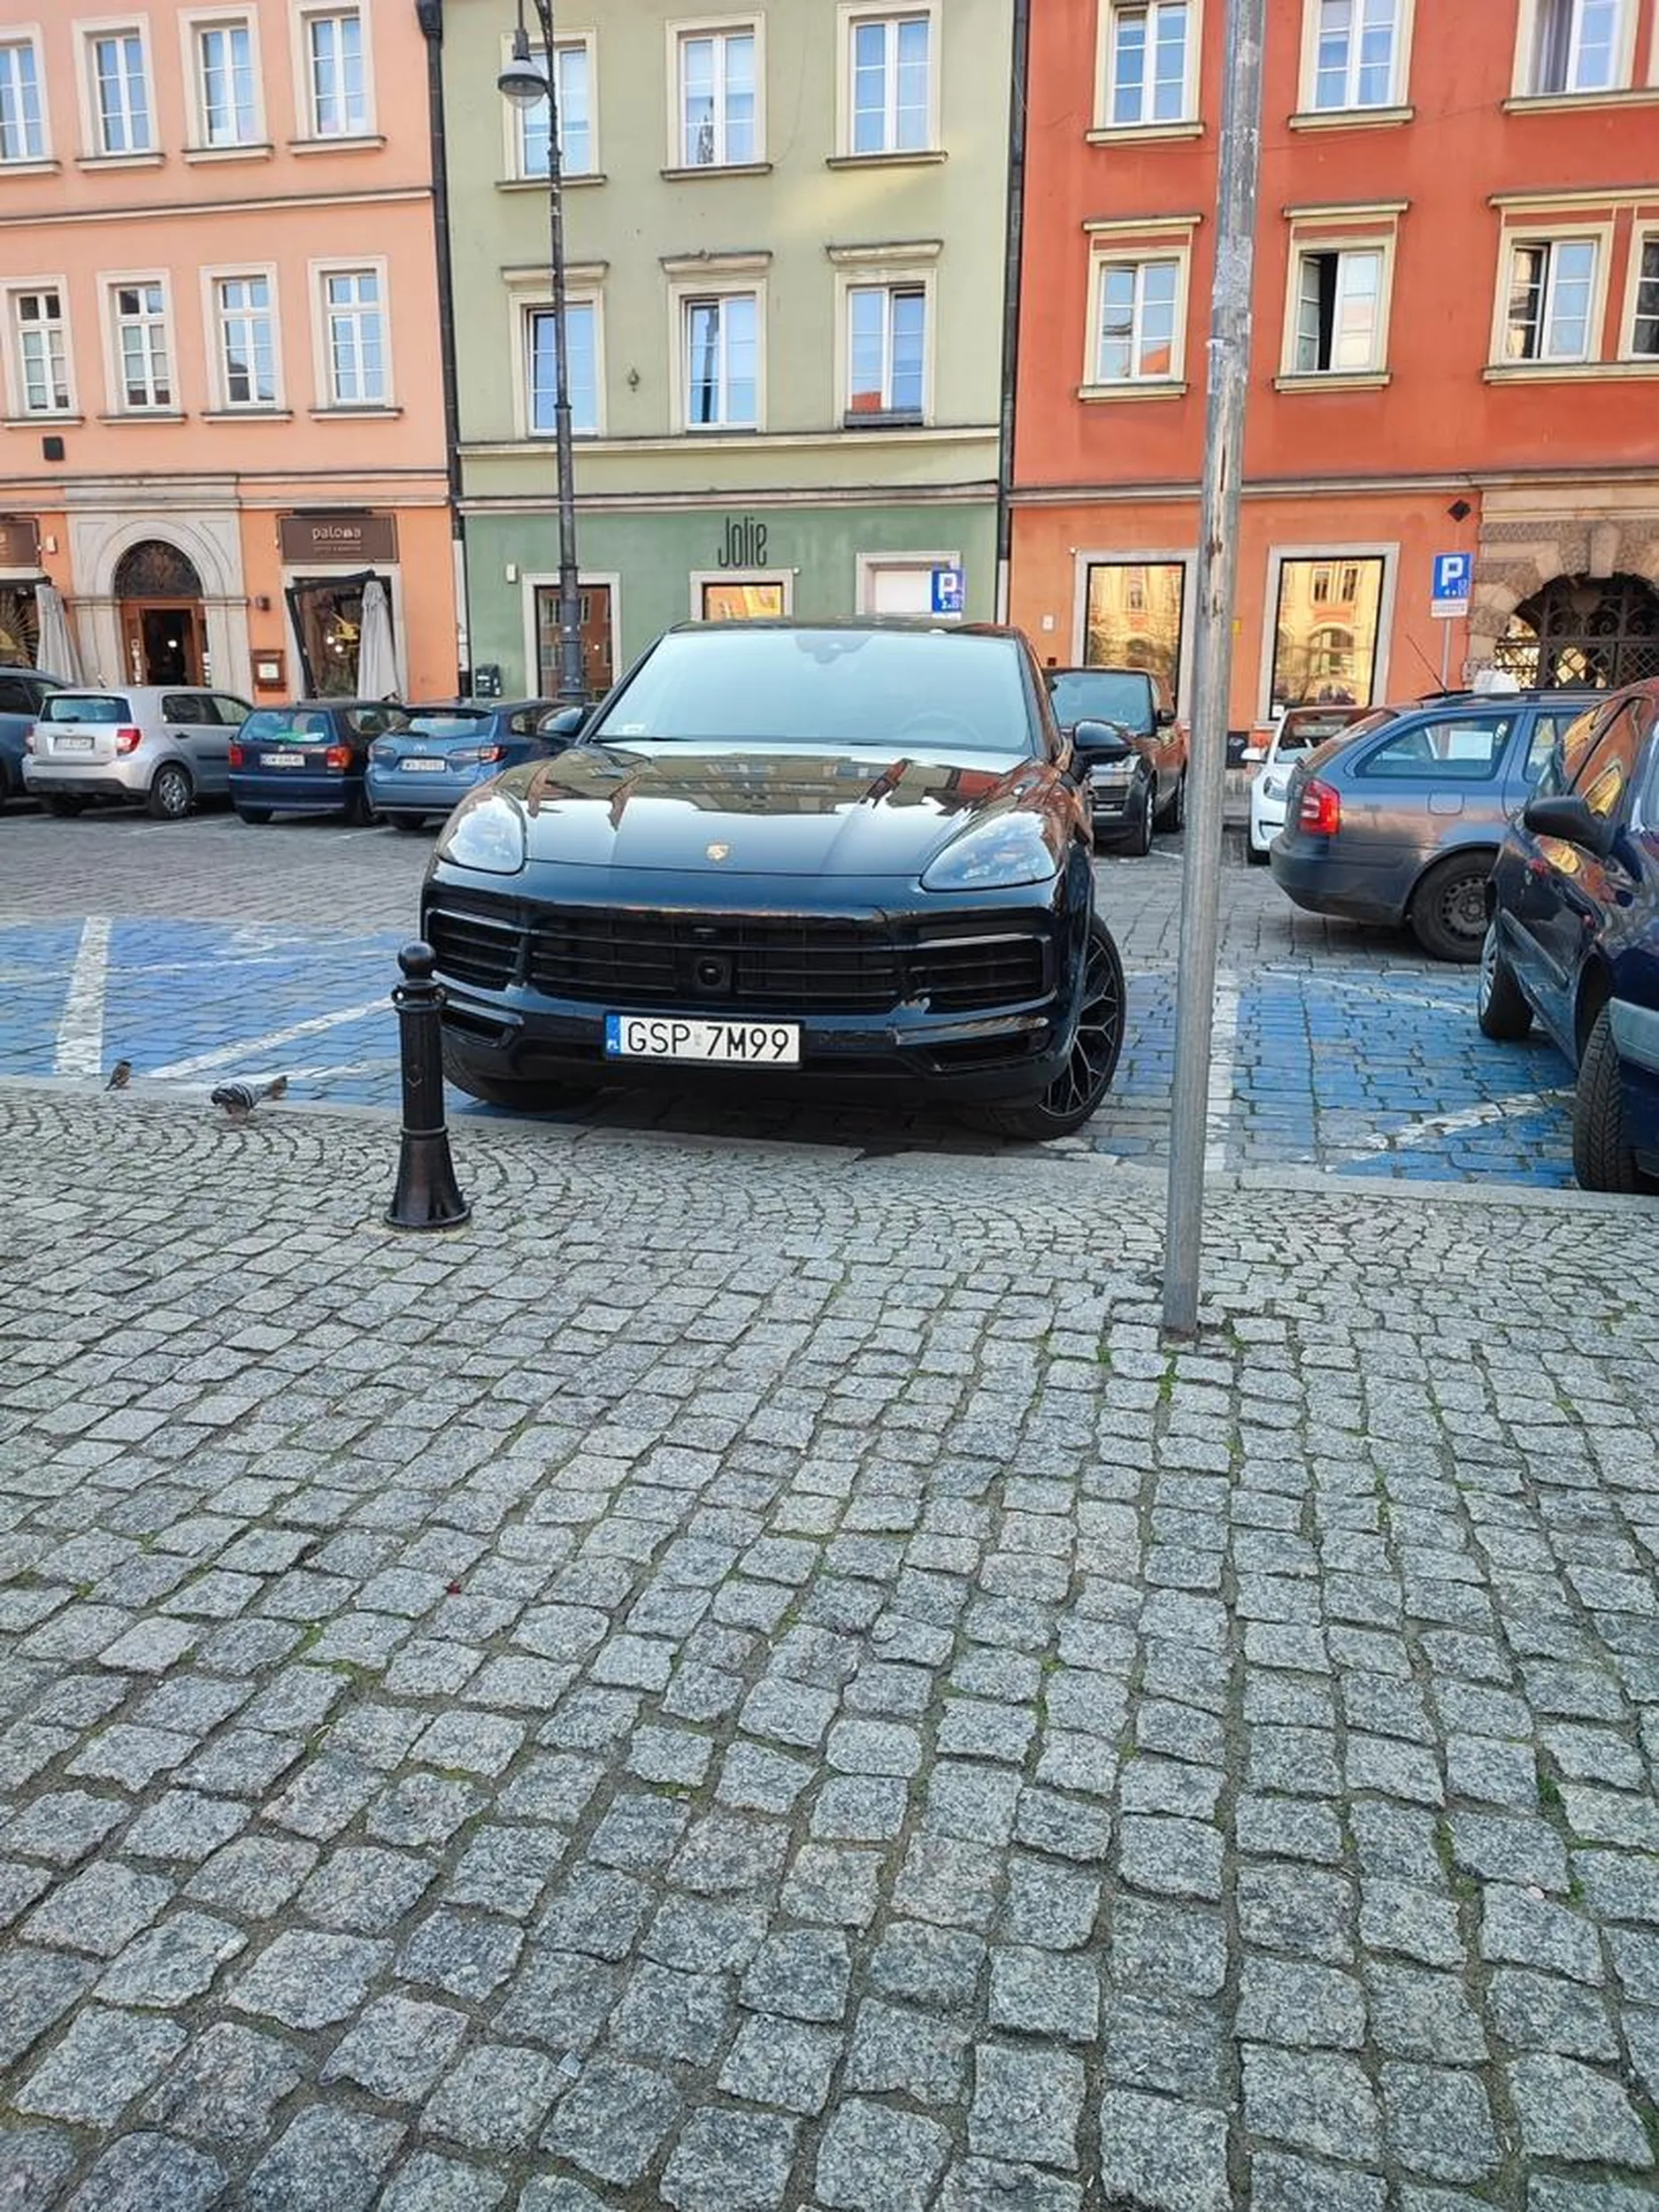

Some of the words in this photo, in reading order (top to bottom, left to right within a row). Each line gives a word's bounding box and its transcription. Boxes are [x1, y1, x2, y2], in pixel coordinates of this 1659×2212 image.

[718, 515, 767, 567] Jolie
[938, 573, 957, 600] P
[1441, 557, 1463, 587] P
[627, 1021, 690, 1054] GSP
[707, 1025, 789, 1059] 7M99
